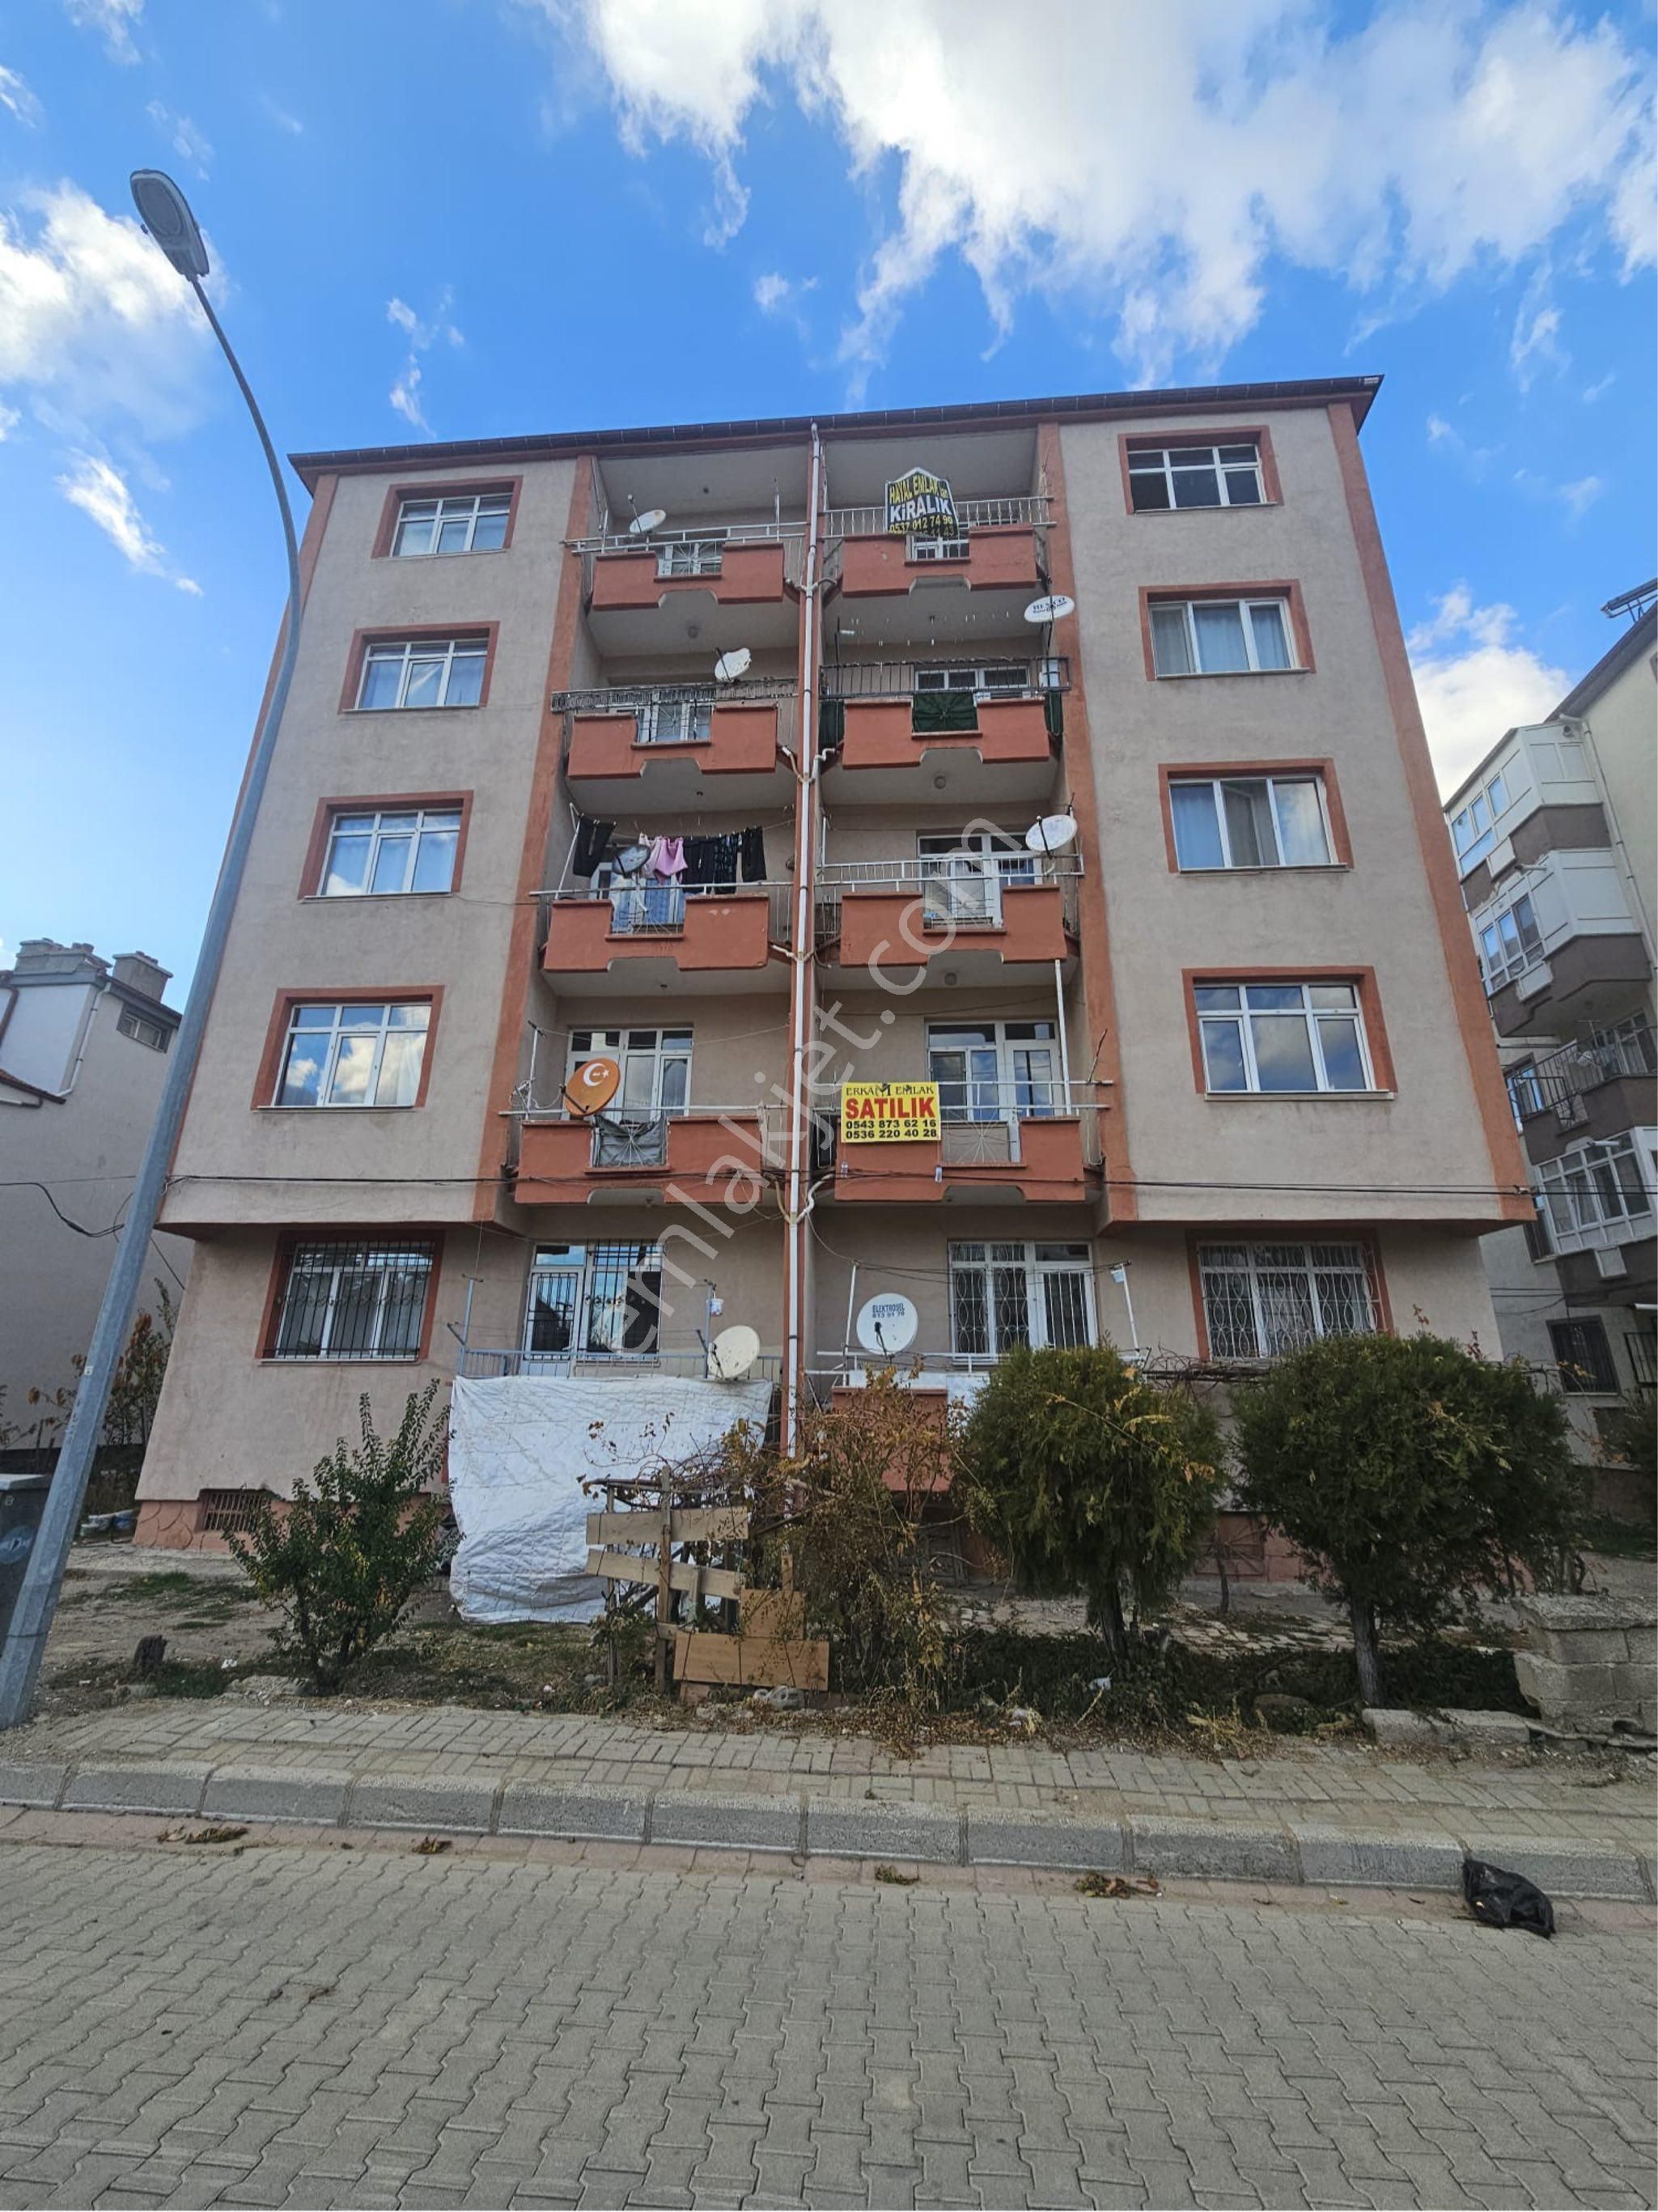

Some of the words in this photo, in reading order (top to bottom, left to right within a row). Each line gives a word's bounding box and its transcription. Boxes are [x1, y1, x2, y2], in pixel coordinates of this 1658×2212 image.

[846, 1097, 935, 1120] SATILIK
[846, 1120, 875, 1129] 0543
[879, 1119, 900, 1128] 873
[904, 1119, 918, 1127] 62
[922, 1119, 936, 1127] 16
[846, 1130, 875, 1139] 0536
[879, 1130, 900, 1138] 220
[905, 1129, 918, 1137] 40
[923, 1128, 937, 1137] 28
